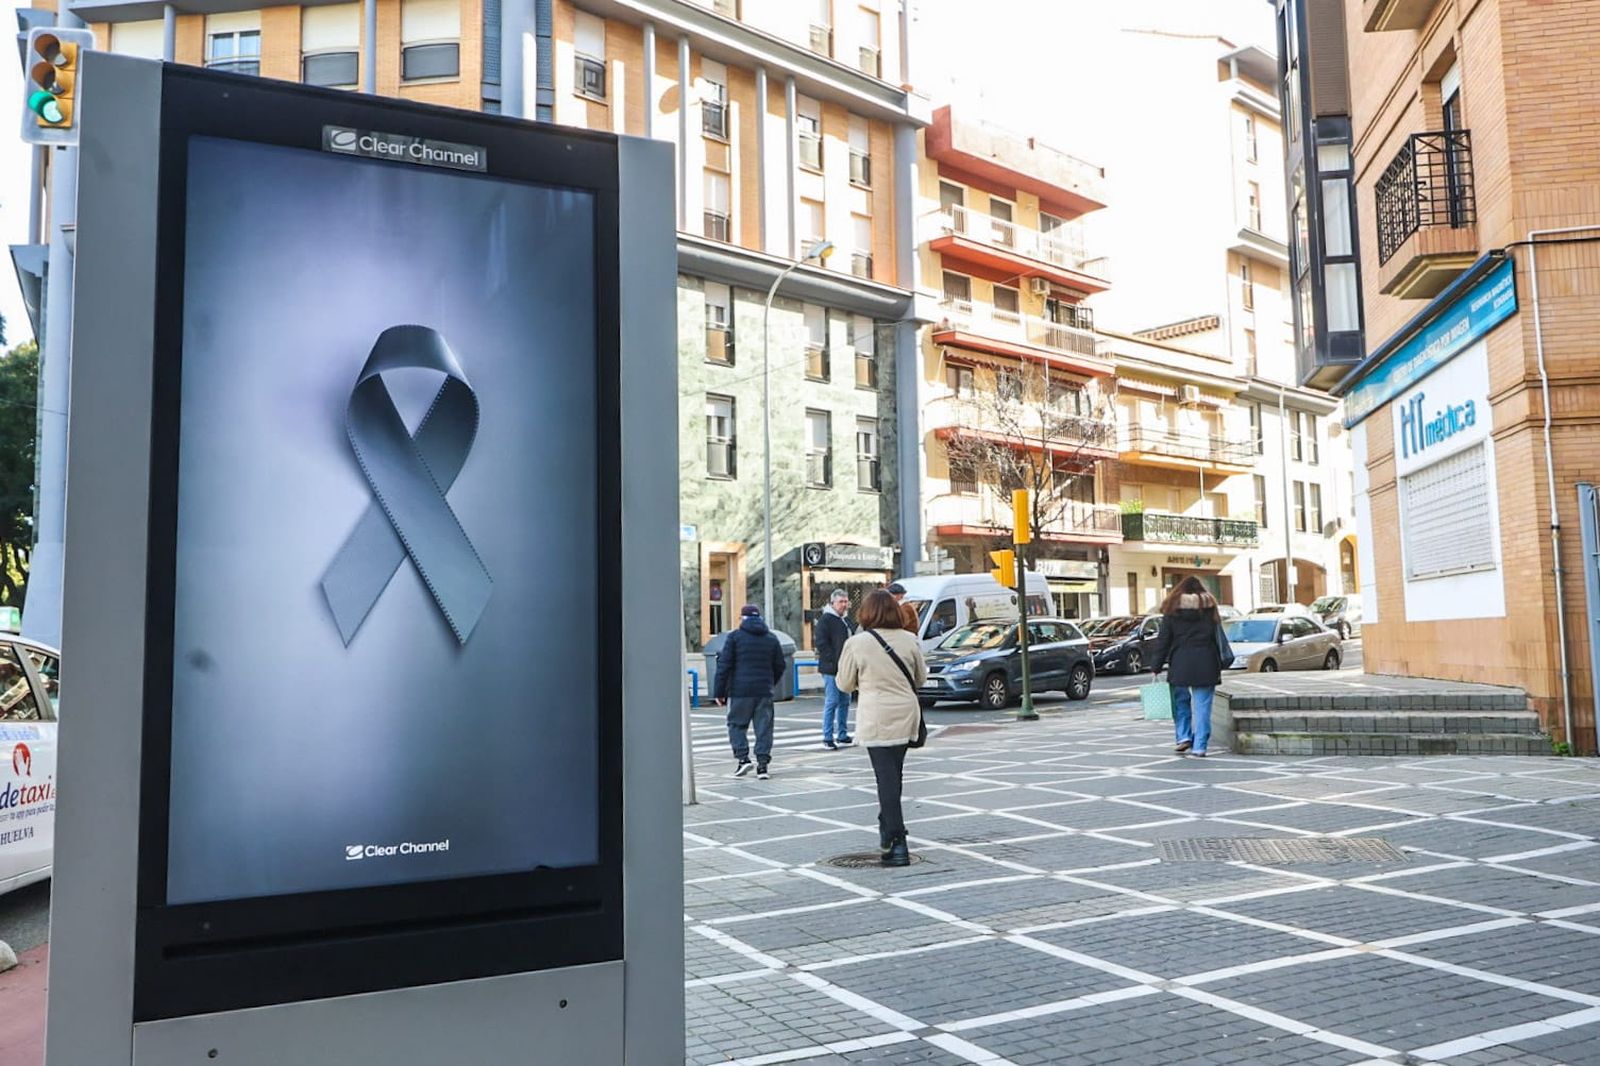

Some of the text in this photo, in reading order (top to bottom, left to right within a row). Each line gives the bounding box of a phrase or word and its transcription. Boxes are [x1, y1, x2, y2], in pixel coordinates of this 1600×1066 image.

[359, 136, 479, 166] Clear Channel
[1400, 391, 1425, 460] HT
[1425, 399, 1475, 447] médica
[0, 826, 34, 846] HUELVA
[365, 839, 450, 857] Clear Channel
